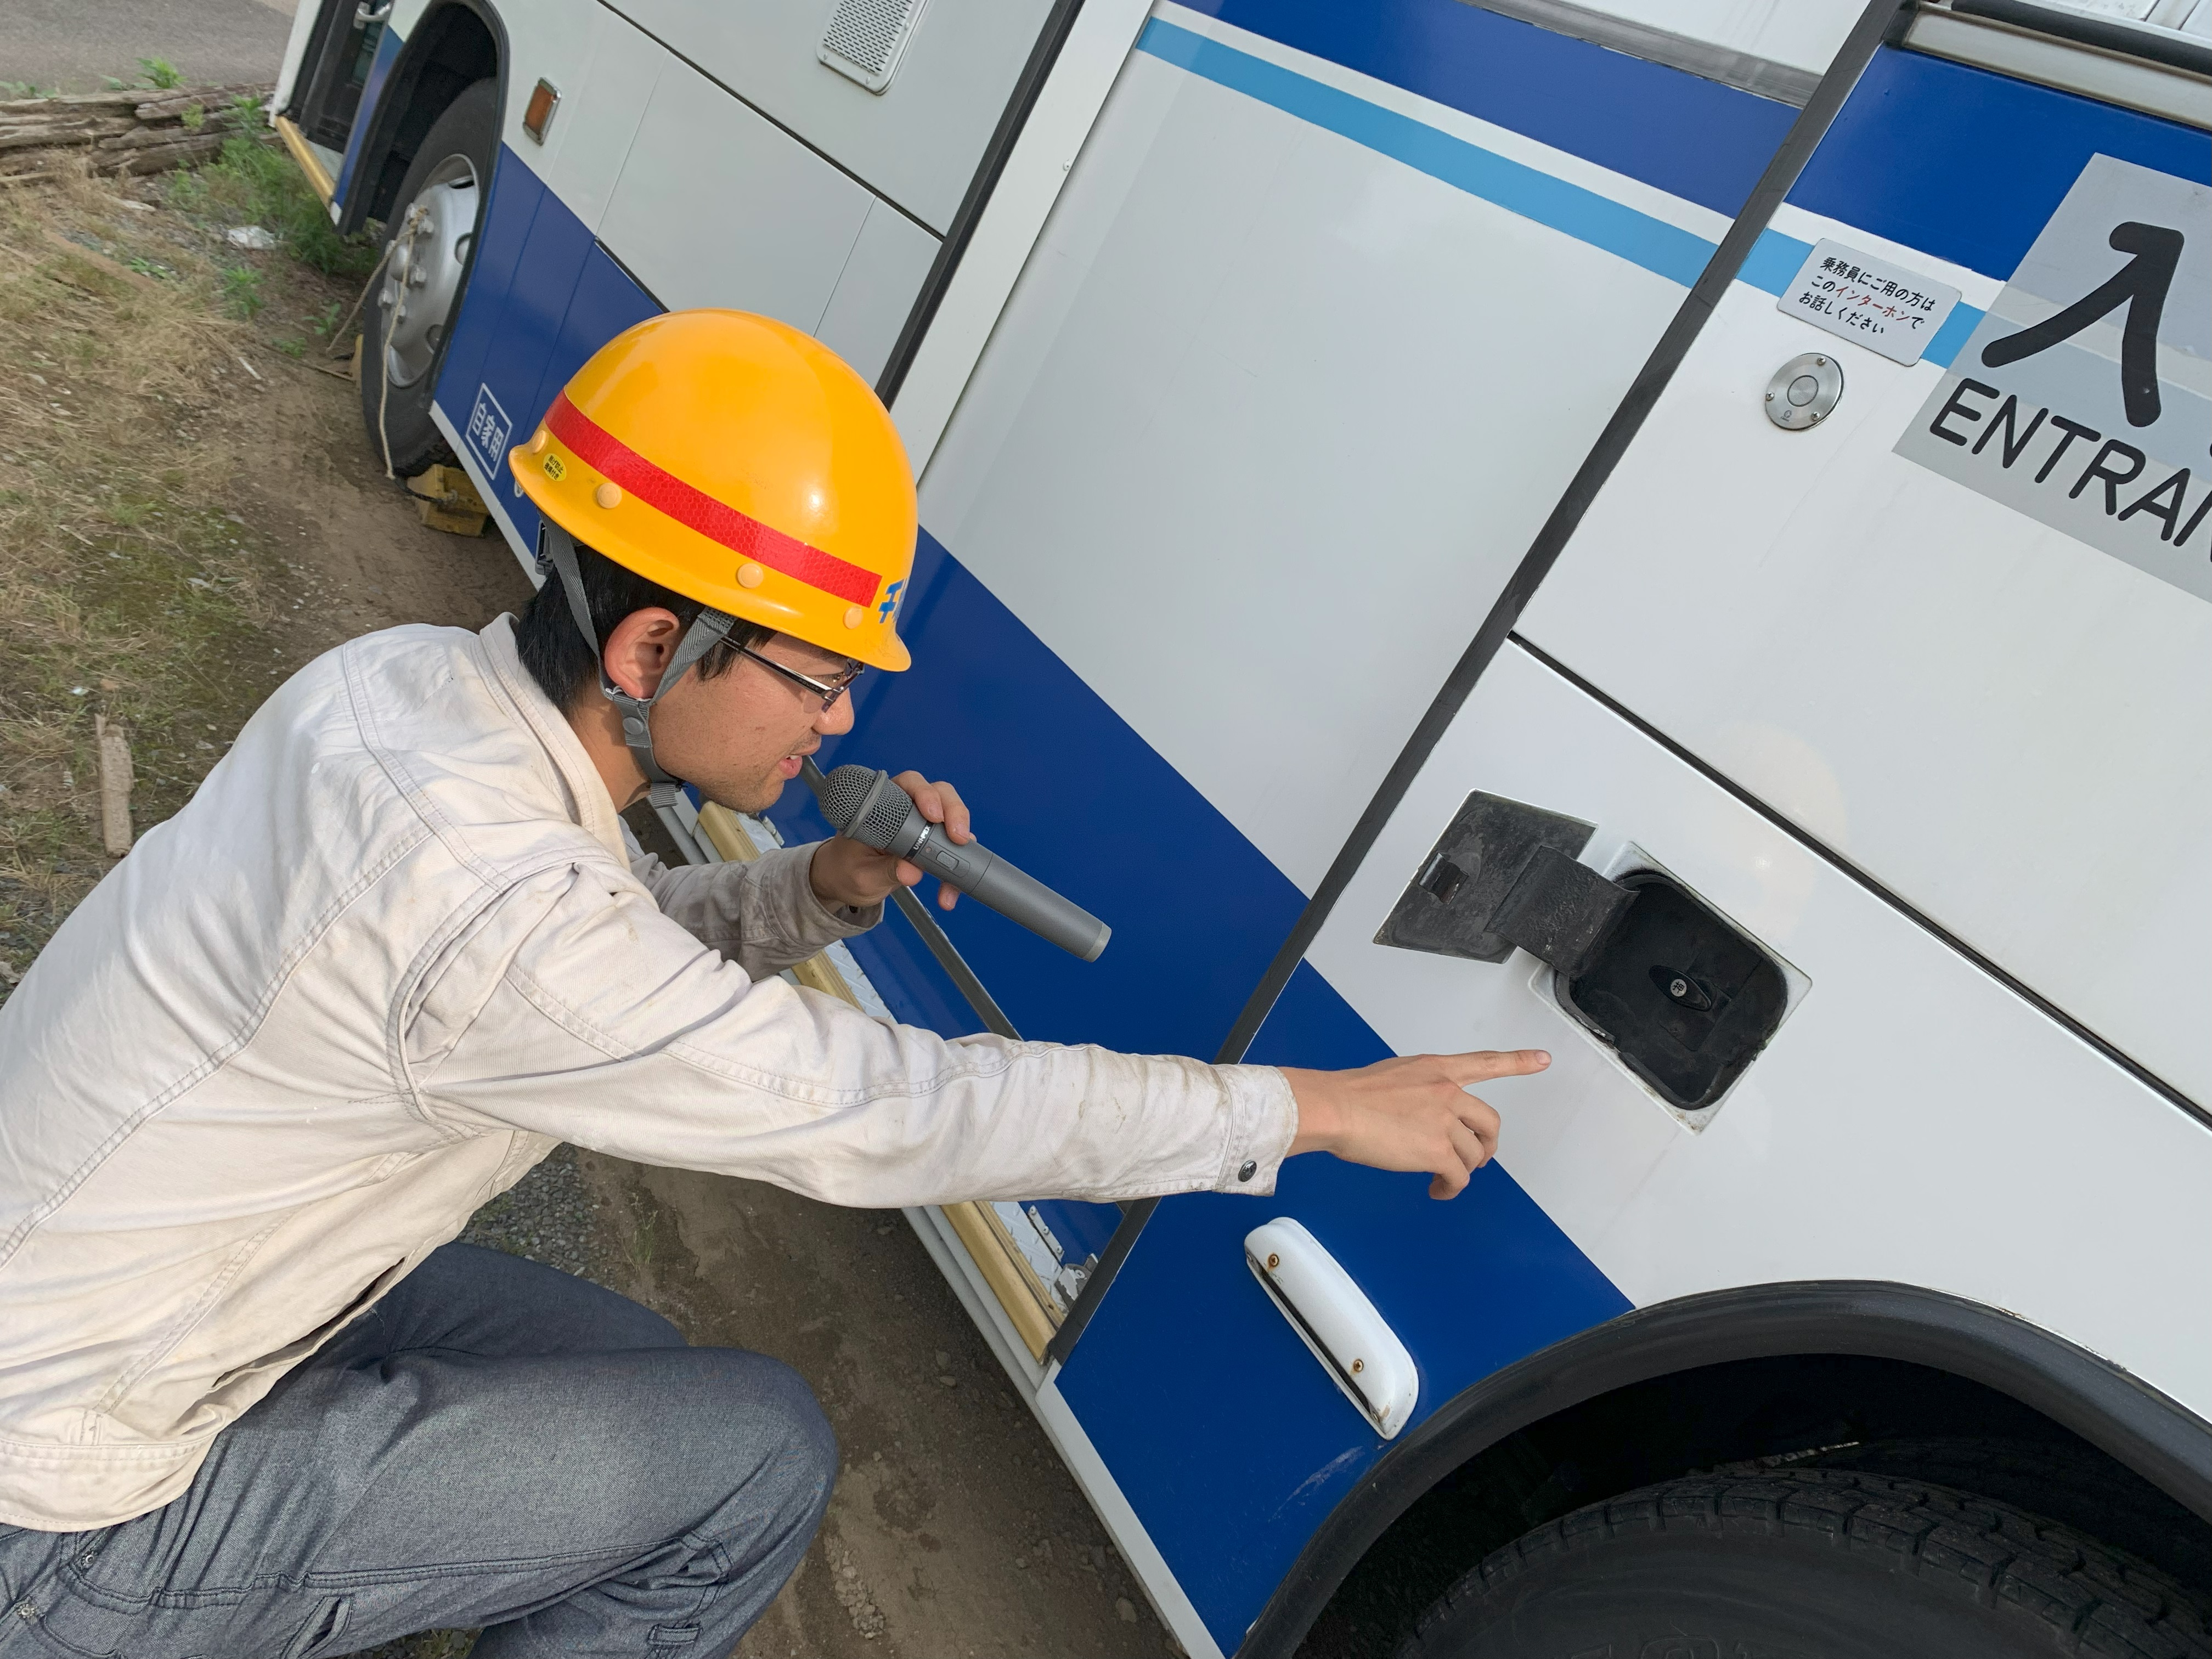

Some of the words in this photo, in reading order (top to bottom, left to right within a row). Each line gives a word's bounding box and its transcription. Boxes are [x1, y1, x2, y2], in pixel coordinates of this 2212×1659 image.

[1812, 275, 1925, 329] このインターホンで
[1820, 257, 1936, 311] 乗務員にご用の方は
[1799, 292, 1884, 334] お話しください
[1981, 221, 2212, 462] 入
[472, 403, 504, 461] 自家用
